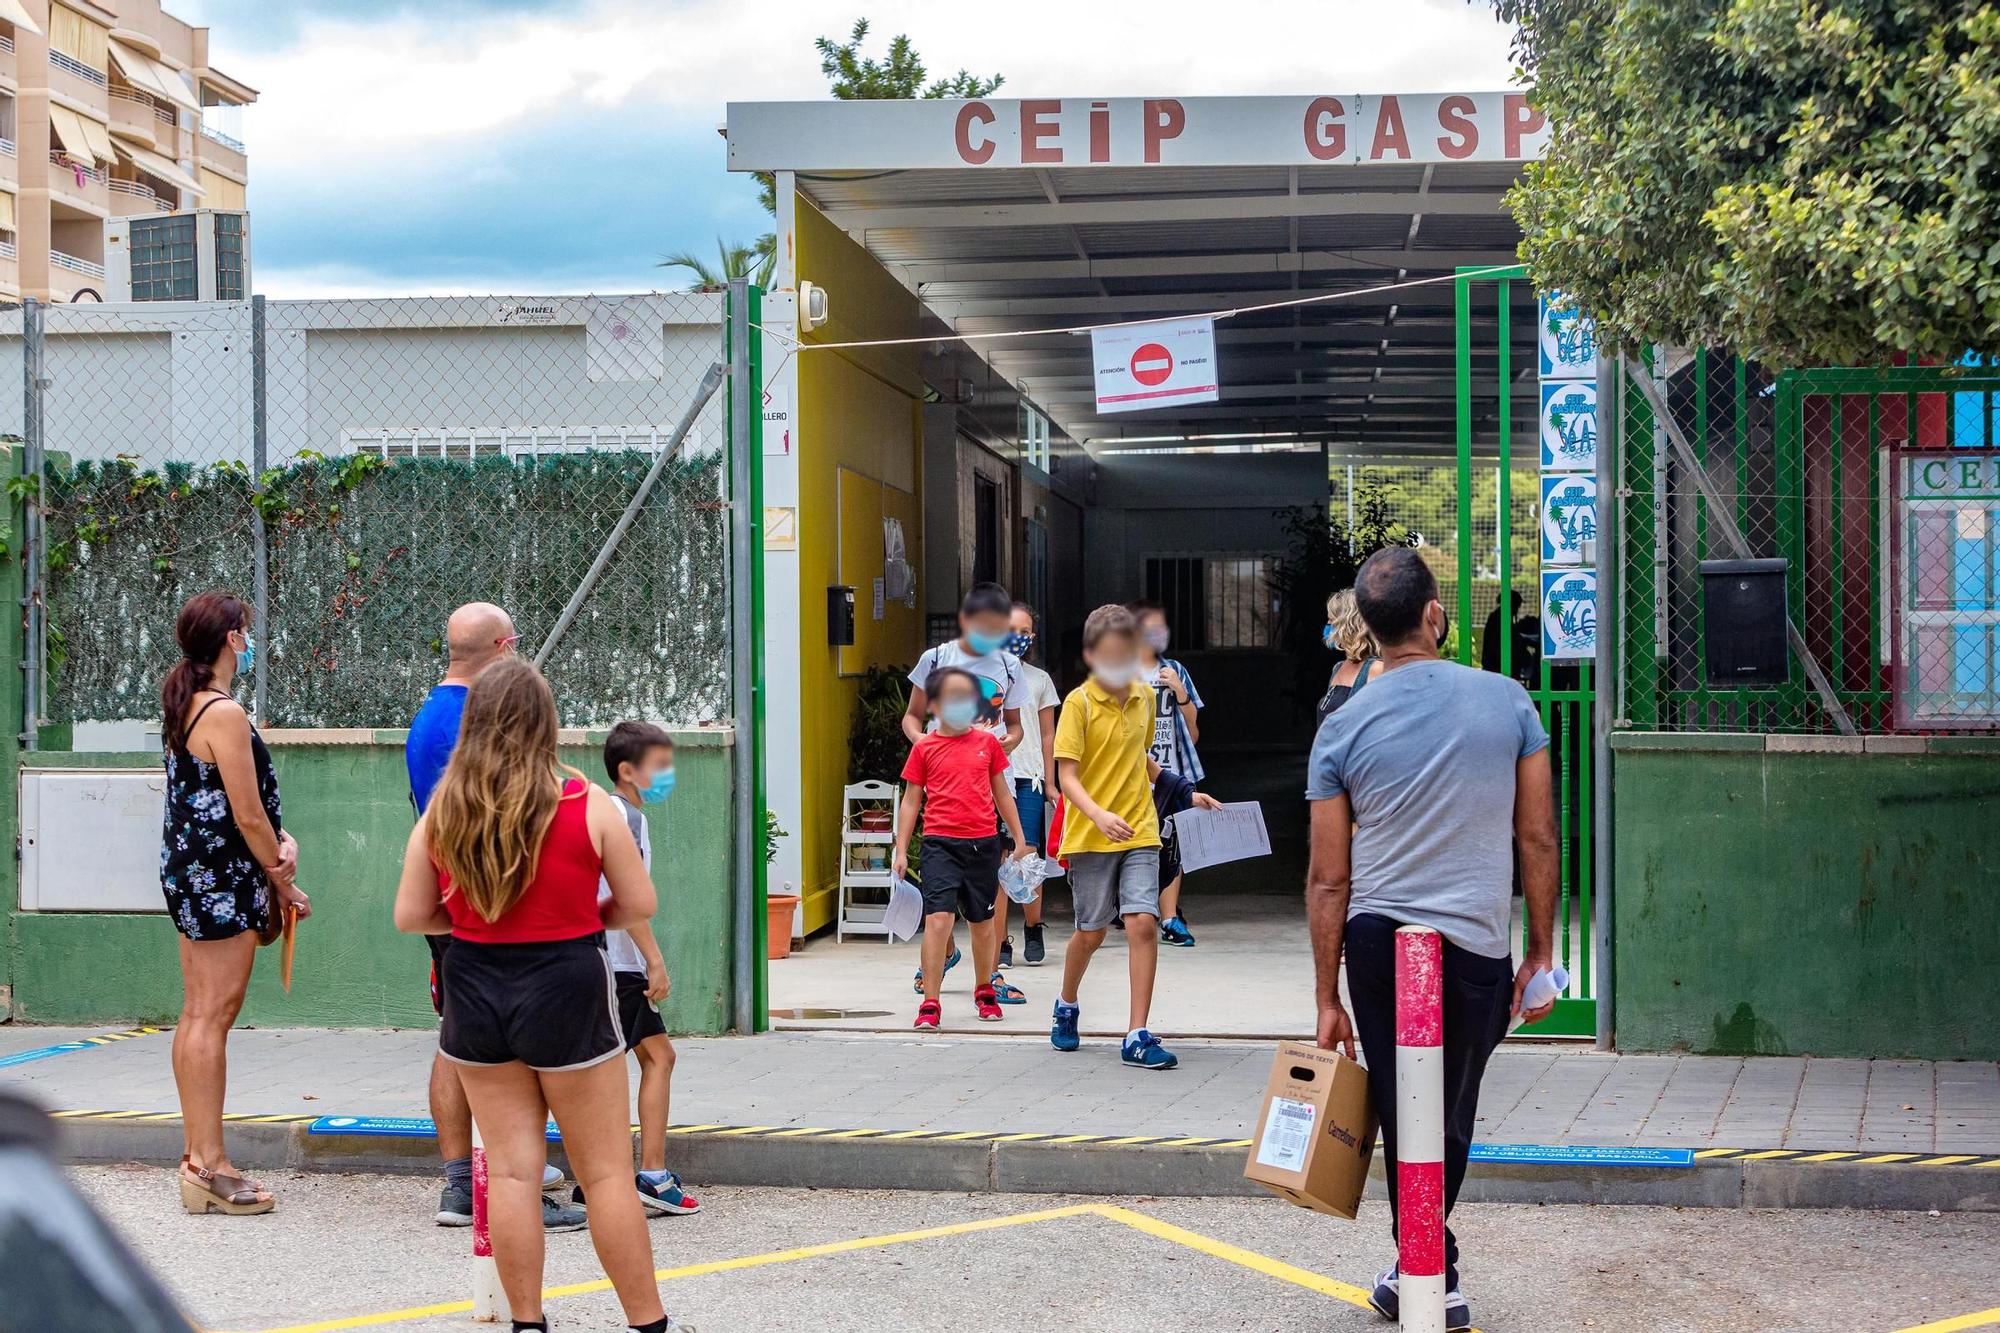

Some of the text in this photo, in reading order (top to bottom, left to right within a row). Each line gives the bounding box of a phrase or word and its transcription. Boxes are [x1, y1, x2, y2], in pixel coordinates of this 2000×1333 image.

[1565, 394, 1586, 404] CEIP
[1550, 403, 1596, 414] GASPARO
[1564, 487, 1585, 497] CEIP
[1550, 496, 1596, 507] GASPARO
[1564, 580, 1586, 591] CEIP
[1549, 590, 1596, 602] GASPARO
[1285, 1050, 1305, 1058] LIBROS
[1316, 1056, 1334, 1064] TEXTO
[1328, 1120, 1356, 1148] Carrefour
